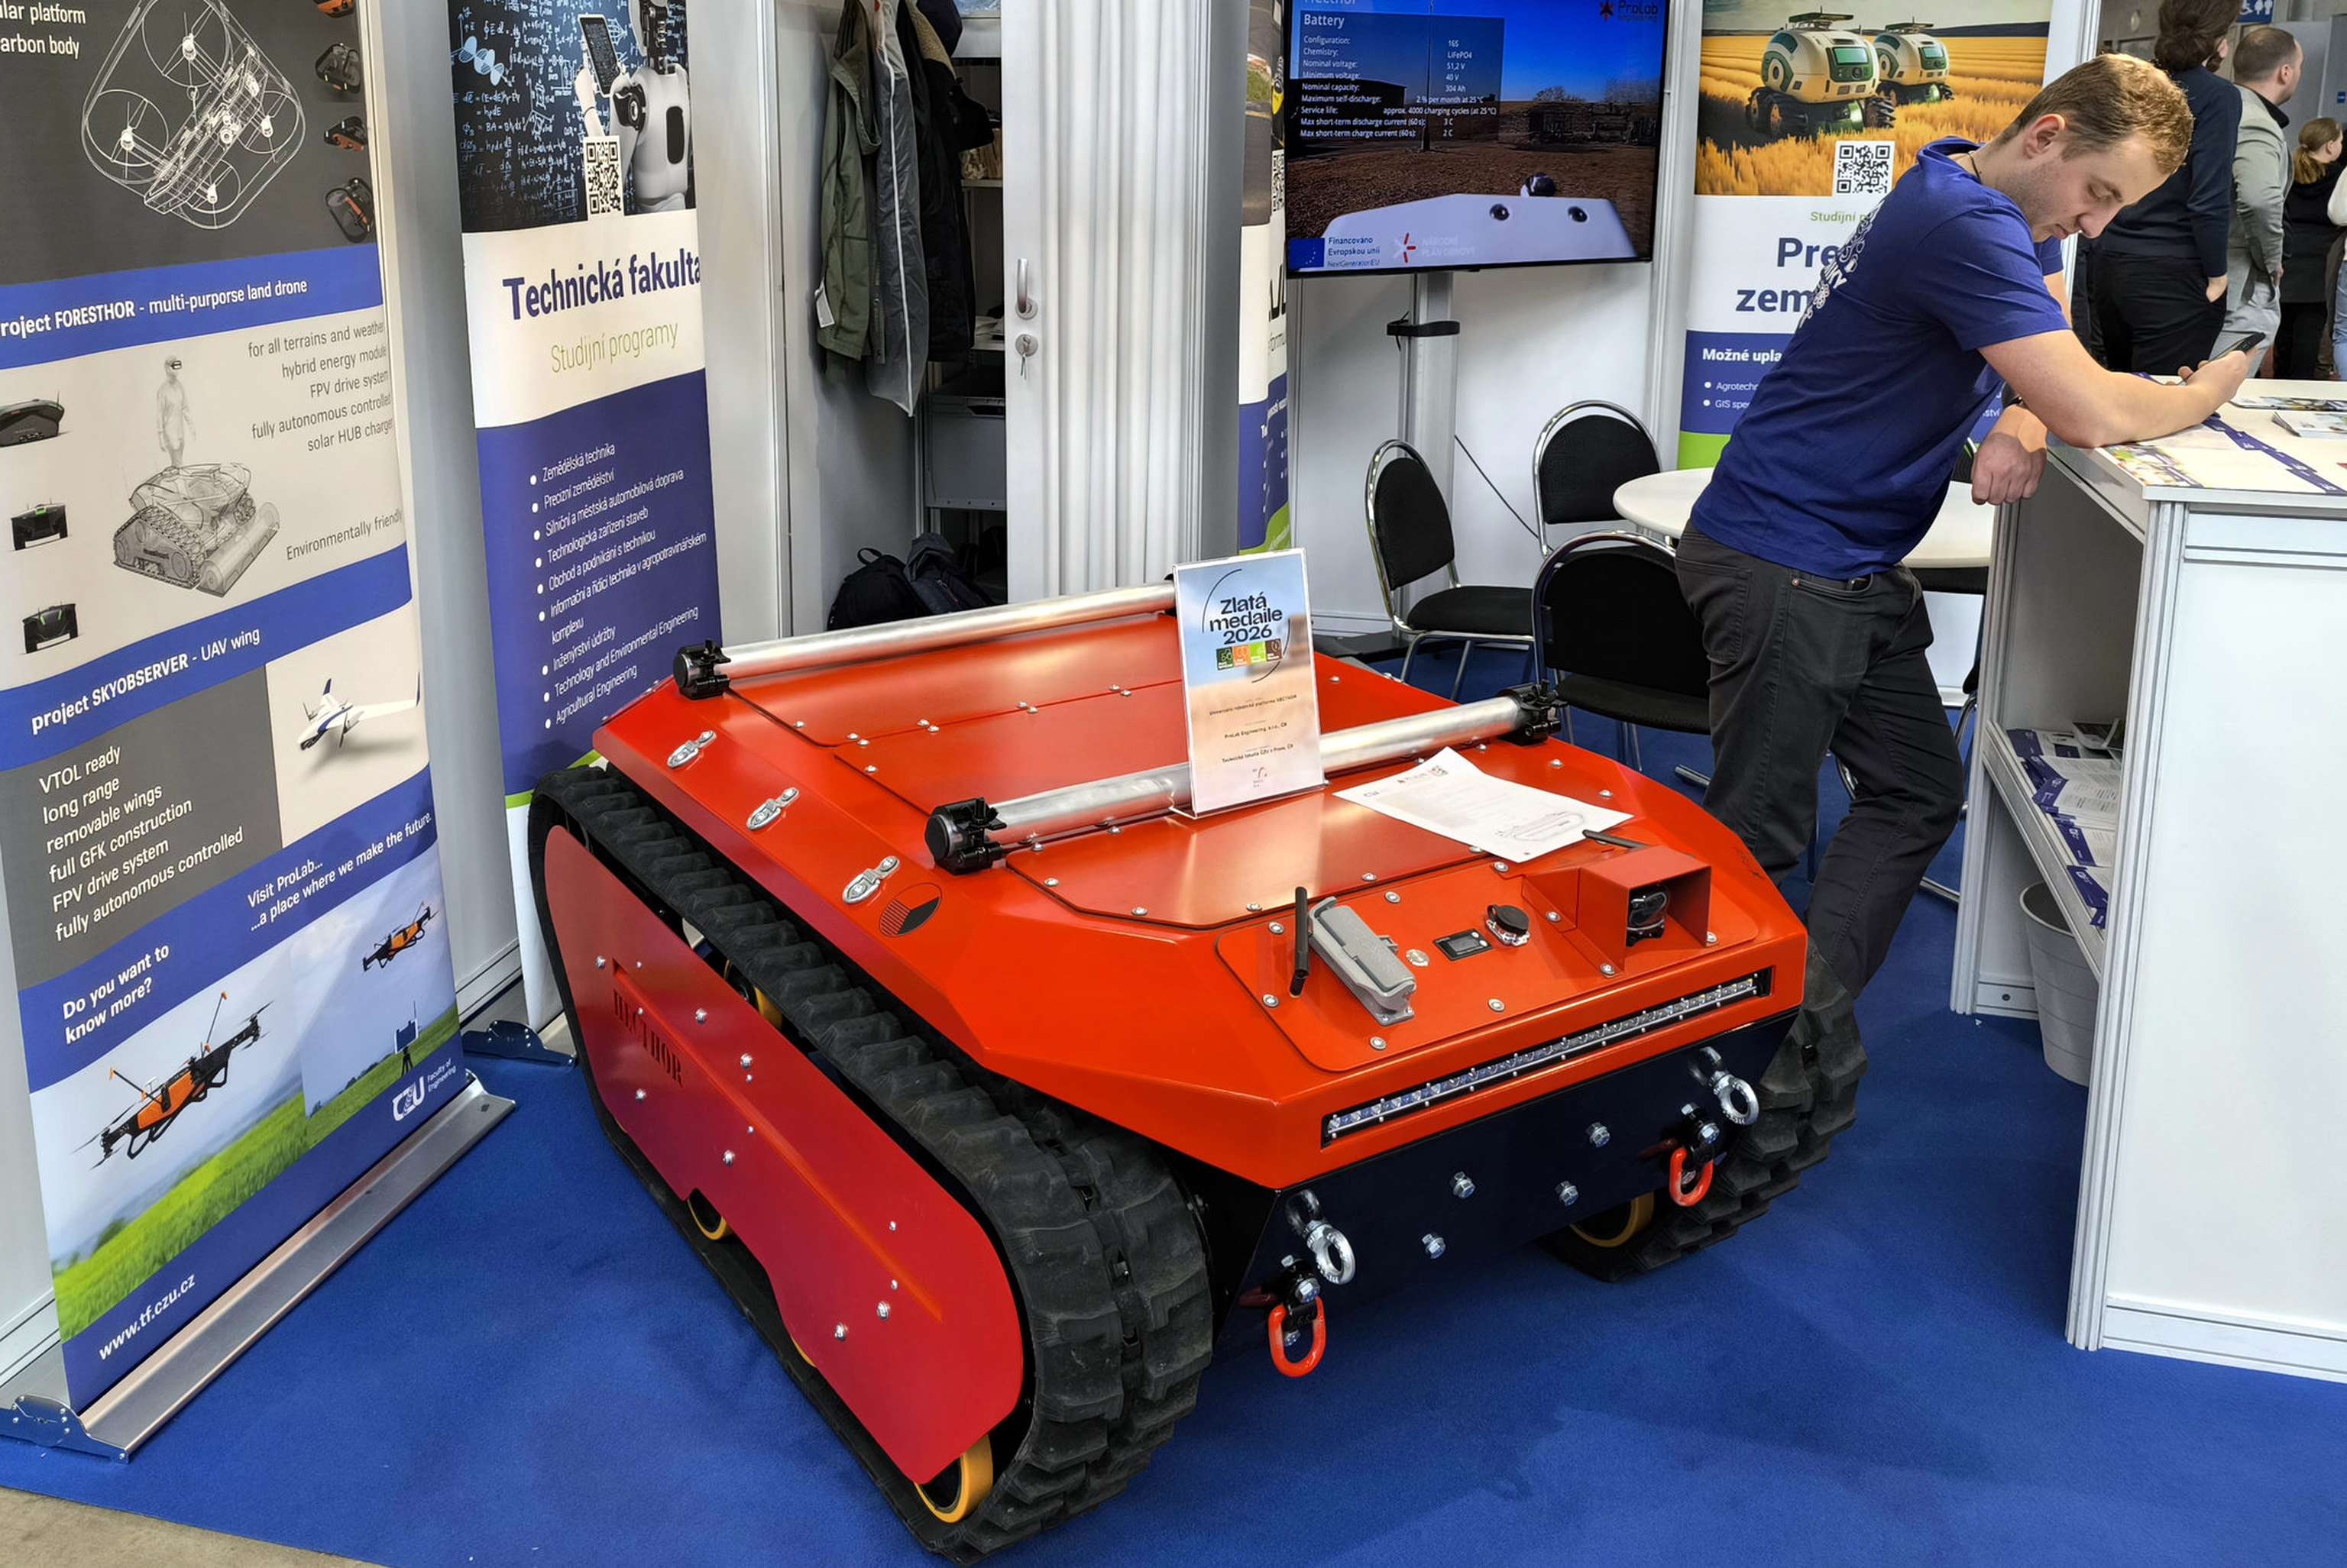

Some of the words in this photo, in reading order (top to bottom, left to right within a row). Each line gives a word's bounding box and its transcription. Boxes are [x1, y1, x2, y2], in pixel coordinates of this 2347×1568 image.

[30, 2, 86, 25] platform
[1304, 14, 1345, 29] Battery
[49, 34, 79, 60] body
[1303, 47, 1339, 57] Chemistry:
[1332, 61, 1358, 70] voltage:
[1331, 83, 1360, 92] capacity:
[1352, 118, 1382, 127] discharge
[1352, 130, 1373, 138] charge
[1811, 211, 1856, 224] Studijní
[1328, 237, 1373, 245] Financováno
[1328, 247, 1365, 257] Evropskou
[502, 258, 624, 320] Technická
[1, 315, 51, 339] roject
[55, 300, 135, 329] FORESTHOR
[149, 289, 244, 314] multi-purporse
[247, 282, 272, 300] land
[274, 280, 308, 296] drone
[248, 342, 264, 357] for
[268, 338, 280, 354] all
[284, 332, 327, 351] terrains
[331, 326, 351, 343] and
[551, 332, 605, 373] Studijní
[610, 322, 678, 364] programy
[1703, 348, 1749, 360] Možné
[1753, 349, 1782, 364] upla
[281, 357, 316, 380] hybrid
[319, 354, 356, 370] energy
[310, 382, 330, 398] FPV
[334, 379, 360, 393] drive
[1714, 399, 1730, 408] GIS
[251, 422, 275, 440] fully
[279, 407, 348, 433] autonomous
[307, 435, 335, 451] solar
[338, 426, 361, 444] HUB
[542, 453, 584, 483] Zemědělská
[585, 443, 615, 465] technika
[544, 485, 571, 509] Precizní
[573, 467, 615, 497] zemědělství
[545, 512, 571, 537] Silniční
[571, 514, 576, 525] a
[578, 496, 608, 522] městská
[609, 477, 654, 509] automobilová
[655, 469, 684, 490] doprava
[286, 521, 371, 561] Environmentally
[547, 528, 597, 564] Technologická
[598, 514, 626, 539] zařízení
[626, 506, 649, 527] staveb
[549, 566, 575, 591] Obchod
[577, 565, 581, 577] a
[582, 545, 617, 577] podnikání
[618, 545, 623, 557] s
[623, 530, 656, 553] technikou
[550, 586, 586, 618] Informační
[587, 586, 591, 598] a
[609, 563, 636, 587] technika
[642, 532, 707, 571] agropotravinářském
[1209, 607, 1283, 632] medaile
[1220, 591, 1267, 614] Zlatá
[552, 617, 584, 645] komplexu
[553, 636, 591, 671] Inženýrství
[592, 626, 616, 648] údržby
[1223, 625, 1272, 645] 2026
[554, 661, 594, 697] Technology
[595, 652, 610, 671] and
[610, 622, 659, 663] Environmental
[659, 606, 699, 635] Engineering
[31, 695, 90, 735] project
[92, 652, 189, 706] SKYOBSERVER
[200, 639, 228, 661] UAV
[231, 629, 261, 649] wing
[556, 685, 595, 725] Agricultural
[597, 665, 637, 698] Engineering
[39, 765, 83, 794] VTOL
[85, 745, 121, 776] ready
[43, 799, 79, 825] long
[82, 778, 120, 807] range
[47, 807, 121, 854] removable
[123, 784, 163, 814] wings
[49, 856, 76, 883] full
[79, 841, 108, 869] GFK
[109, 800, 193, 852] construction
[52, 884, 83, 913] FPV
[87, 866, 119, 896] drive
[122, 839, 170, 875] system
[55, 914, 89, 942] fully
[93, 865, 175, 923] autonomous
[178, 826, 244, 873] controlled
[247, 884, 274, 908] Visit
[277, 858, 323, 892] ProLab...
[270, 892, 300, 923] place
[303, 870, 336, 899] where
[337, 859, 354, 877] we
[356, 841, 384, 867] make
[386, 829, 403, 849] the
[63, 997, 86, 1020] Do
[89, 978, 115, 1008] you
[118, 953, 152, 985] want
[154, 945, 170, 962] to
[65, 1009, 107, 1045] know
[110, 977, 152, 1017] more?
[99, 1274, 196, 1359] www.tf.czu.cz
